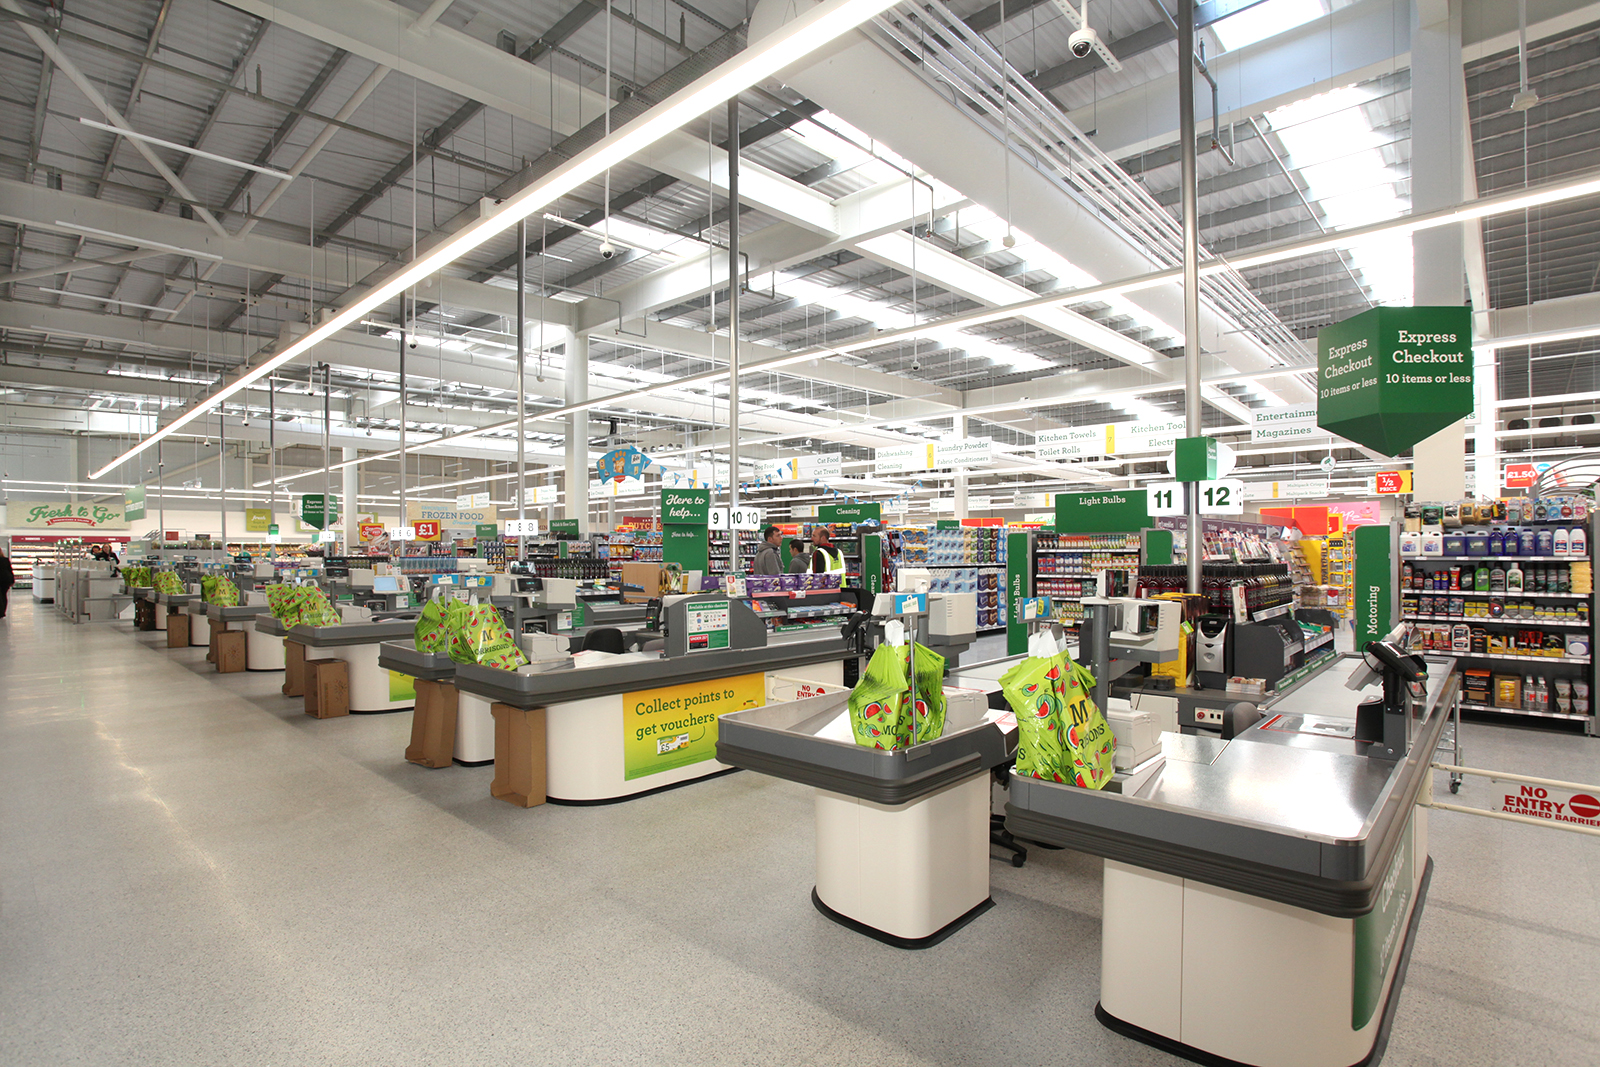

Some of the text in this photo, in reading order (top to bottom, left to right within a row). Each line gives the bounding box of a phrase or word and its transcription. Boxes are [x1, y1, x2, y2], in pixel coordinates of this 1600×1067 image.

[1398, 330, 1457, 346] Express
[1328, 338, 1368, 360] Express
[1392, 350, 1464, 364] Checkout
[1324, 355, 1373, 380] Checkout
[1385, 373, 1471, 384] 10 items or less
[1320, 376, 1378, 399] 10 items or less
[1131, 420, 1186, 434] Kitchen Tool
[1256, 425, 1312, 439] Magazines
[1038, 430, 1097, 443] Kitchen Towels
[937, 441, 989, 453] Laundry Powder
[1148, 439, 1175, 448] Electr
[877, 450, 913, 458] Dishwashing
[1038, 446, 1081, 457] Toilet Rolls
[953, 456, 989, 464] Conditioners
[877, 463, 903, 471] Cleaning
[1507, 470, 1536, 479] £1.50
[665, 493, 706, 505] Here to
[1079, 495, 1126, 507] Light Bulbs
[1154, 489, 1173, 509] 11
[1203, 486, 1231, 507] 12
[26, 504, 74, 523] Fresh
[77, 506, 89, 518] to
[92, 505, 117, 524] Go
[421, 511, 484, 521] FROZEN FOOD
[669, 507, 701, 519] help...
[712, 512, 719, 525] 9
[731, 511, 759, 525] 10 10
[836, 508, 861, 516] Cleaning
[418, 524, 435, 536] £1
[1013, 574, 1021, 596] Bulbs
[1366, 585, 1381, 635] Motoring
[482, 629, 494, 642] M
[801, 684, 811, 692] NO
[635, 689, 735, 716] Collect points to
[1069, 699, 1090, 728] M
[635, 712, 715, 741] get vouchers
[660, 742, 670, 751] £5
[1520, 785, 1548, 799] NO
[1504, 794, 1566, 814] ENTRY
[1502, 805, 1552, 819] ALARMED
